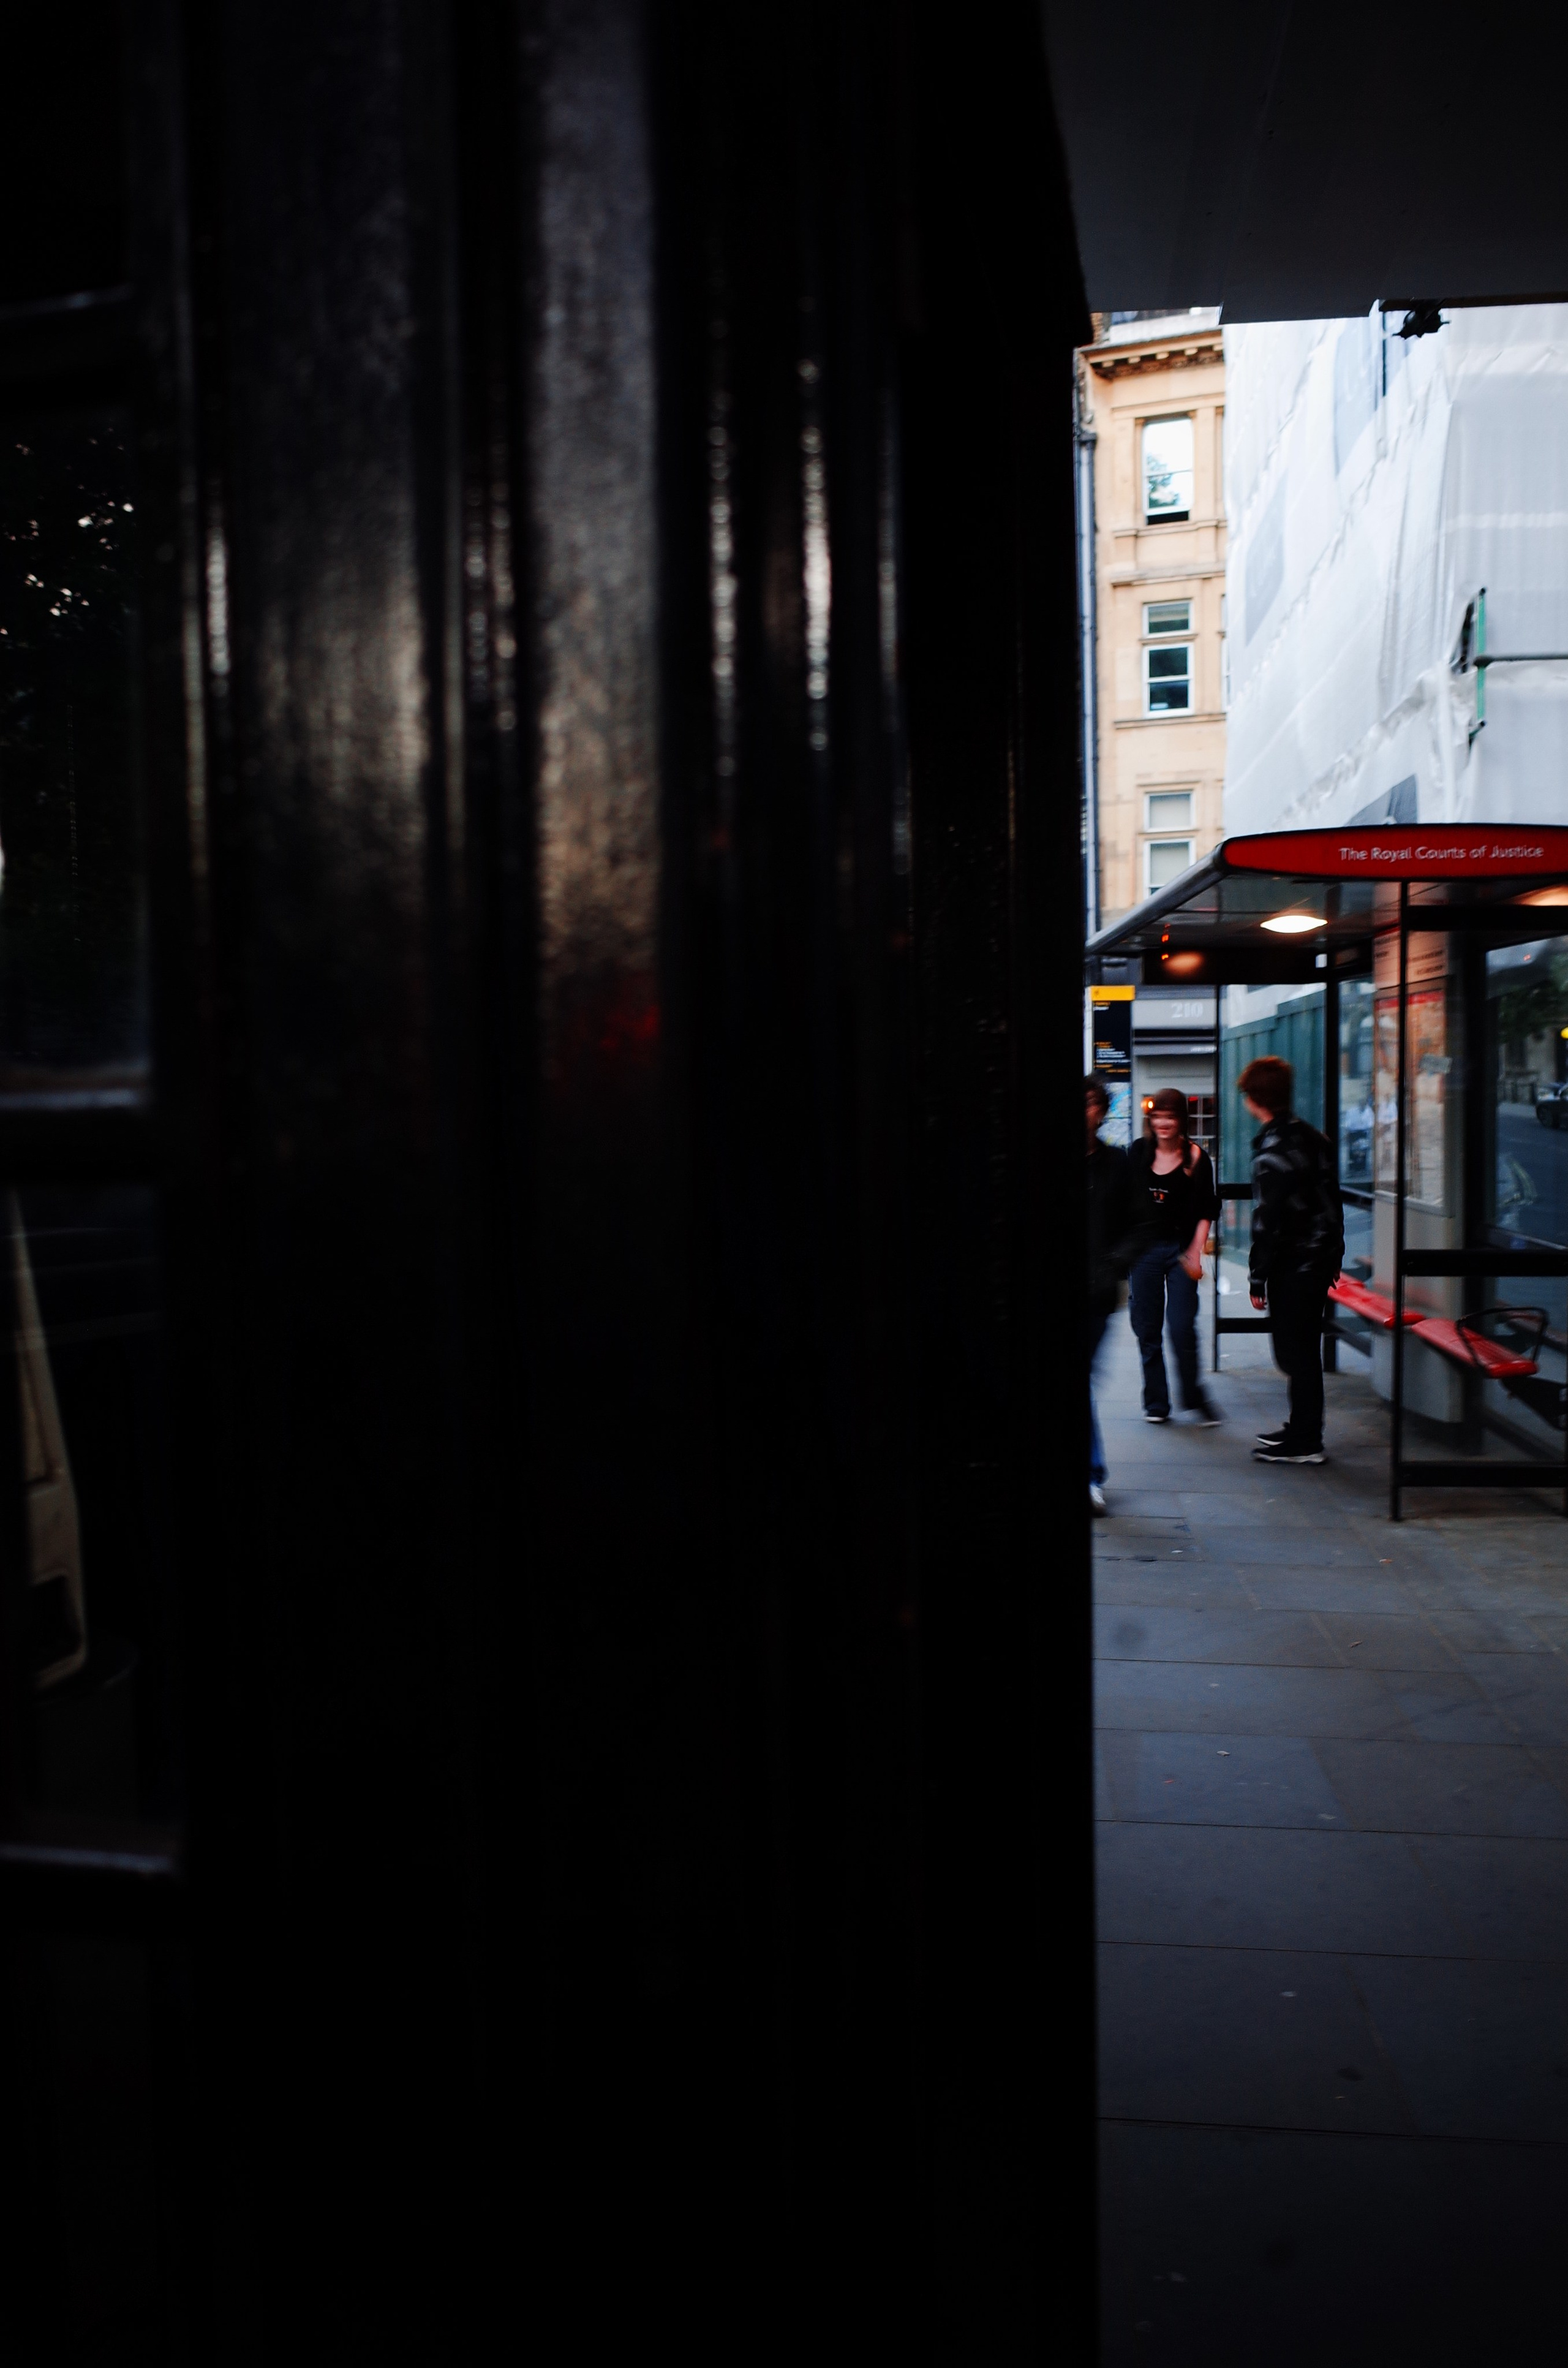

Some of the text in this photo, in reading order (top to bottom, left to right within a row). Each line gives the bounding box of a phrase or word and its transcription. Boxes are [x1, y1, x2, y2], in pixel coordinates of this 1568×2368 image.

[1338, 845, 1544, 863] The Royal Courts of Justice
[1171, 1002, 1204, 1018] 210
